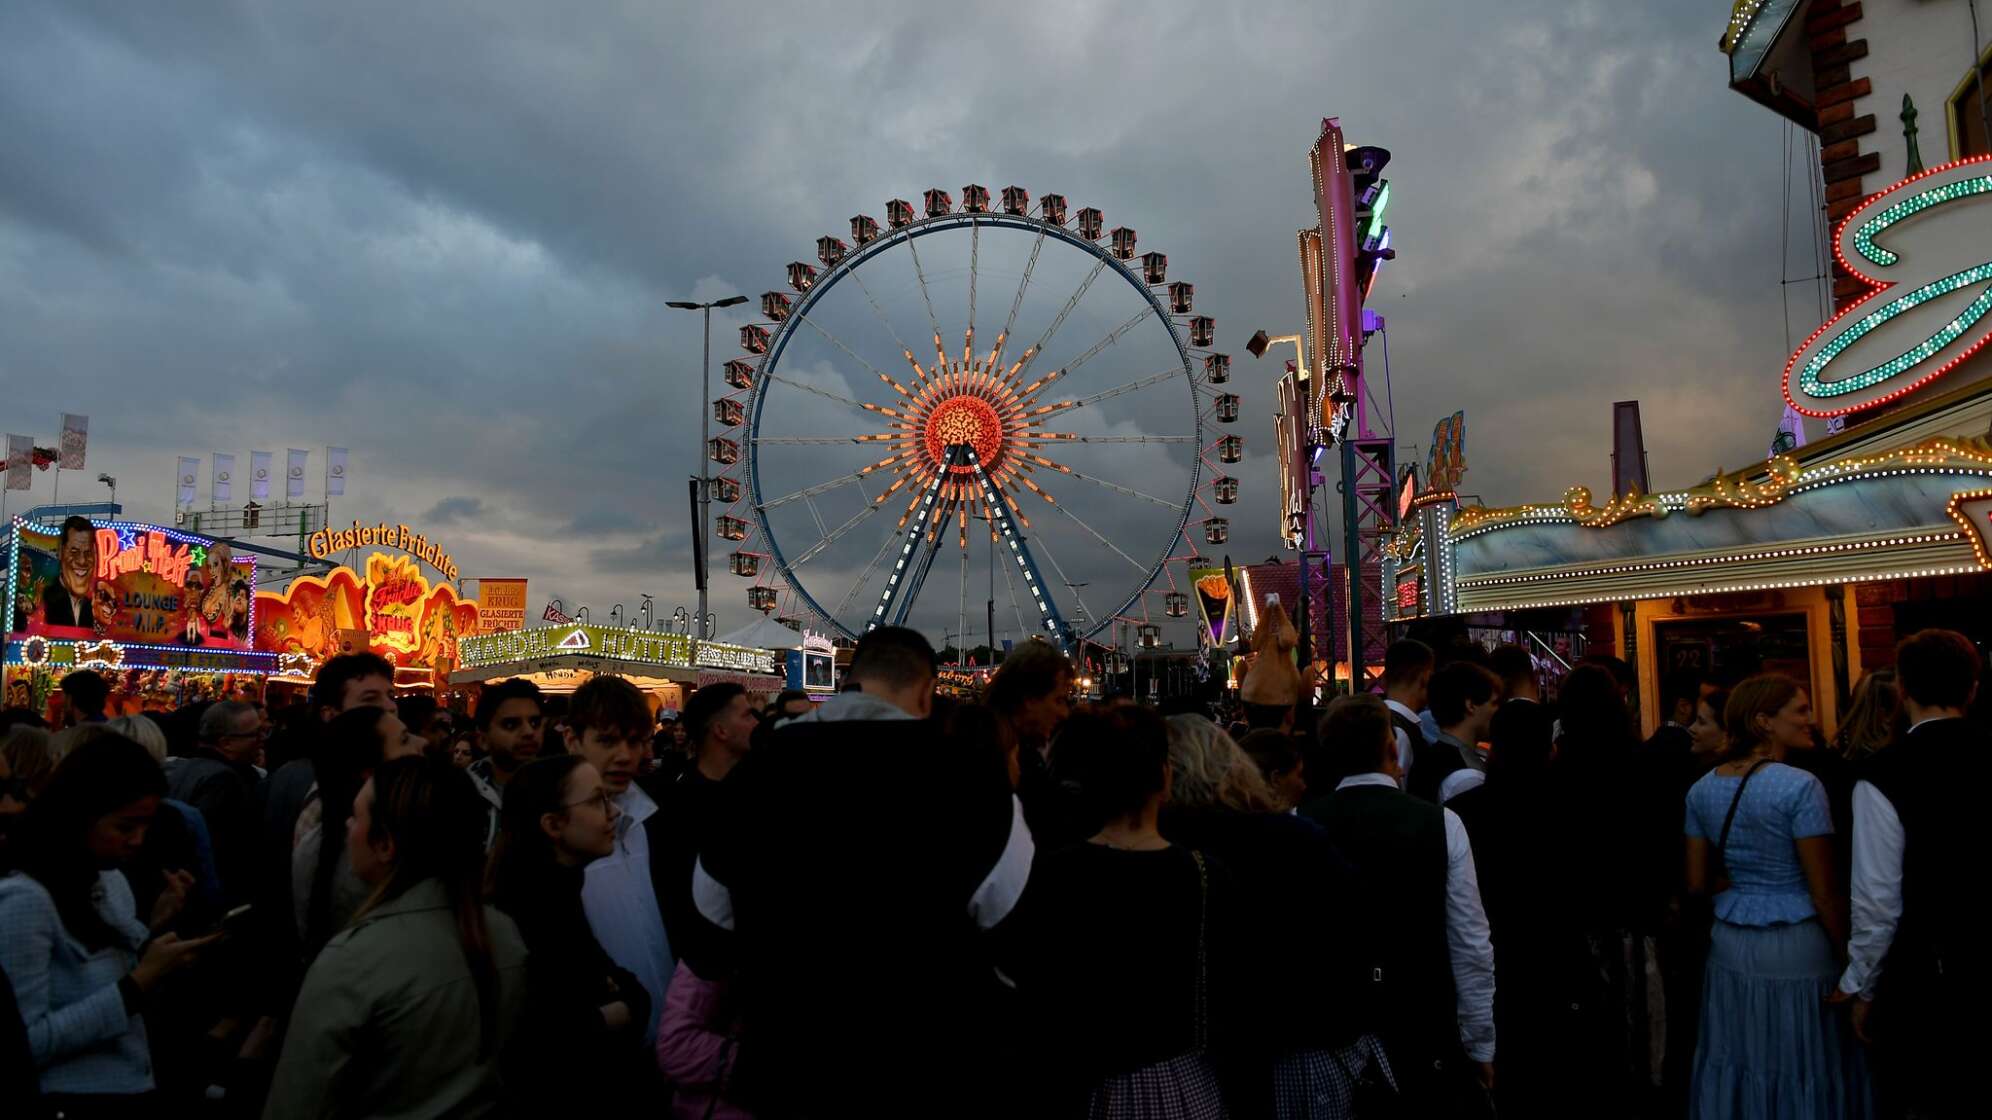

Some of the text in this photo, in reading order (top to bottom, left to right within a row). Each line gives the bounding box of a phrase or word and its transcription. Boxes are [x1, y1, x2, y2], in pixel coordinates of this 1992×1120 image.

[95, 528, 146, 580] Promi
[309, 520, 458, 581] Glasierte Früchte
[124, 591, 178, 611] LOUNGE
[487, 596, 518, 608] KRUG
[480, 609, 524, 619] GLASIERTE
[482, 618, 520, 629] FRÜCHTE
[464, 630, 555, 664] MANDEL
[601, 632, 685, 668] HÜTTE
